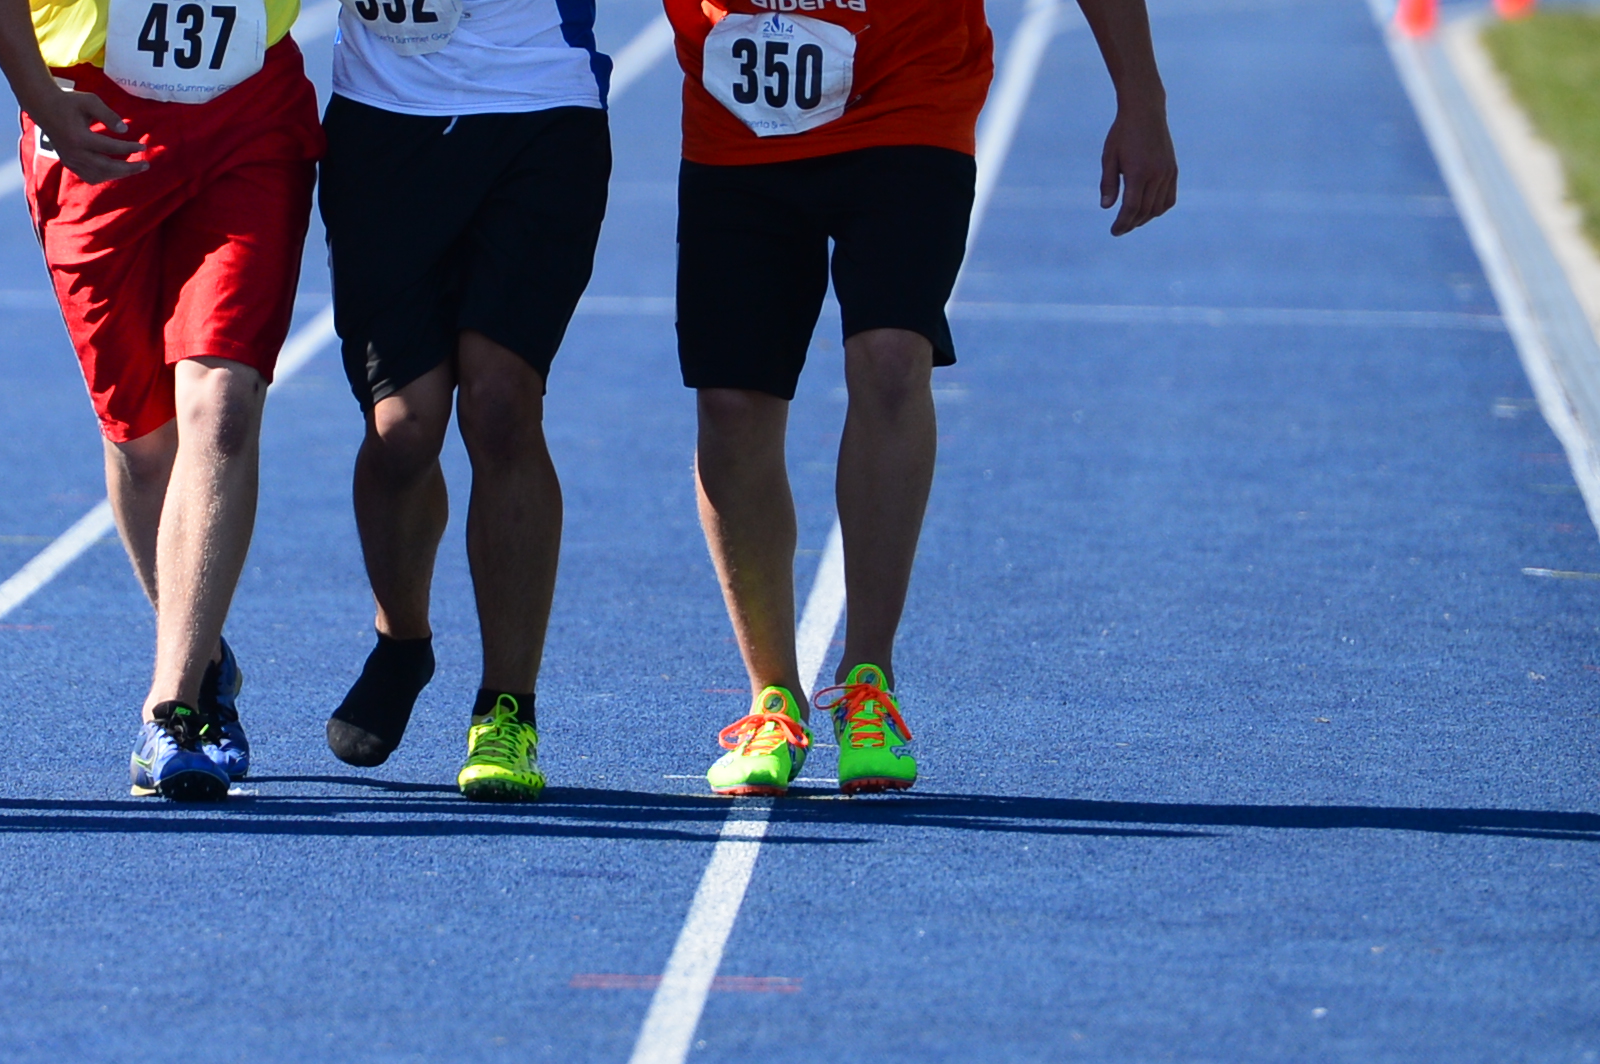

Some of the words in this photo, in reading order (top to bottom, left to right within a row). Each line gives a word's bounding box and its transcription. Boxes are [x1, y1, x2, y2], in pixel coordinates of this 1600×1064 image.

[137, 2, 237, 70] 437
[140, 82, 175, 92] Alberta
[176, 83, 215, 93] Summer
[732, 38, 823, 110] 350
